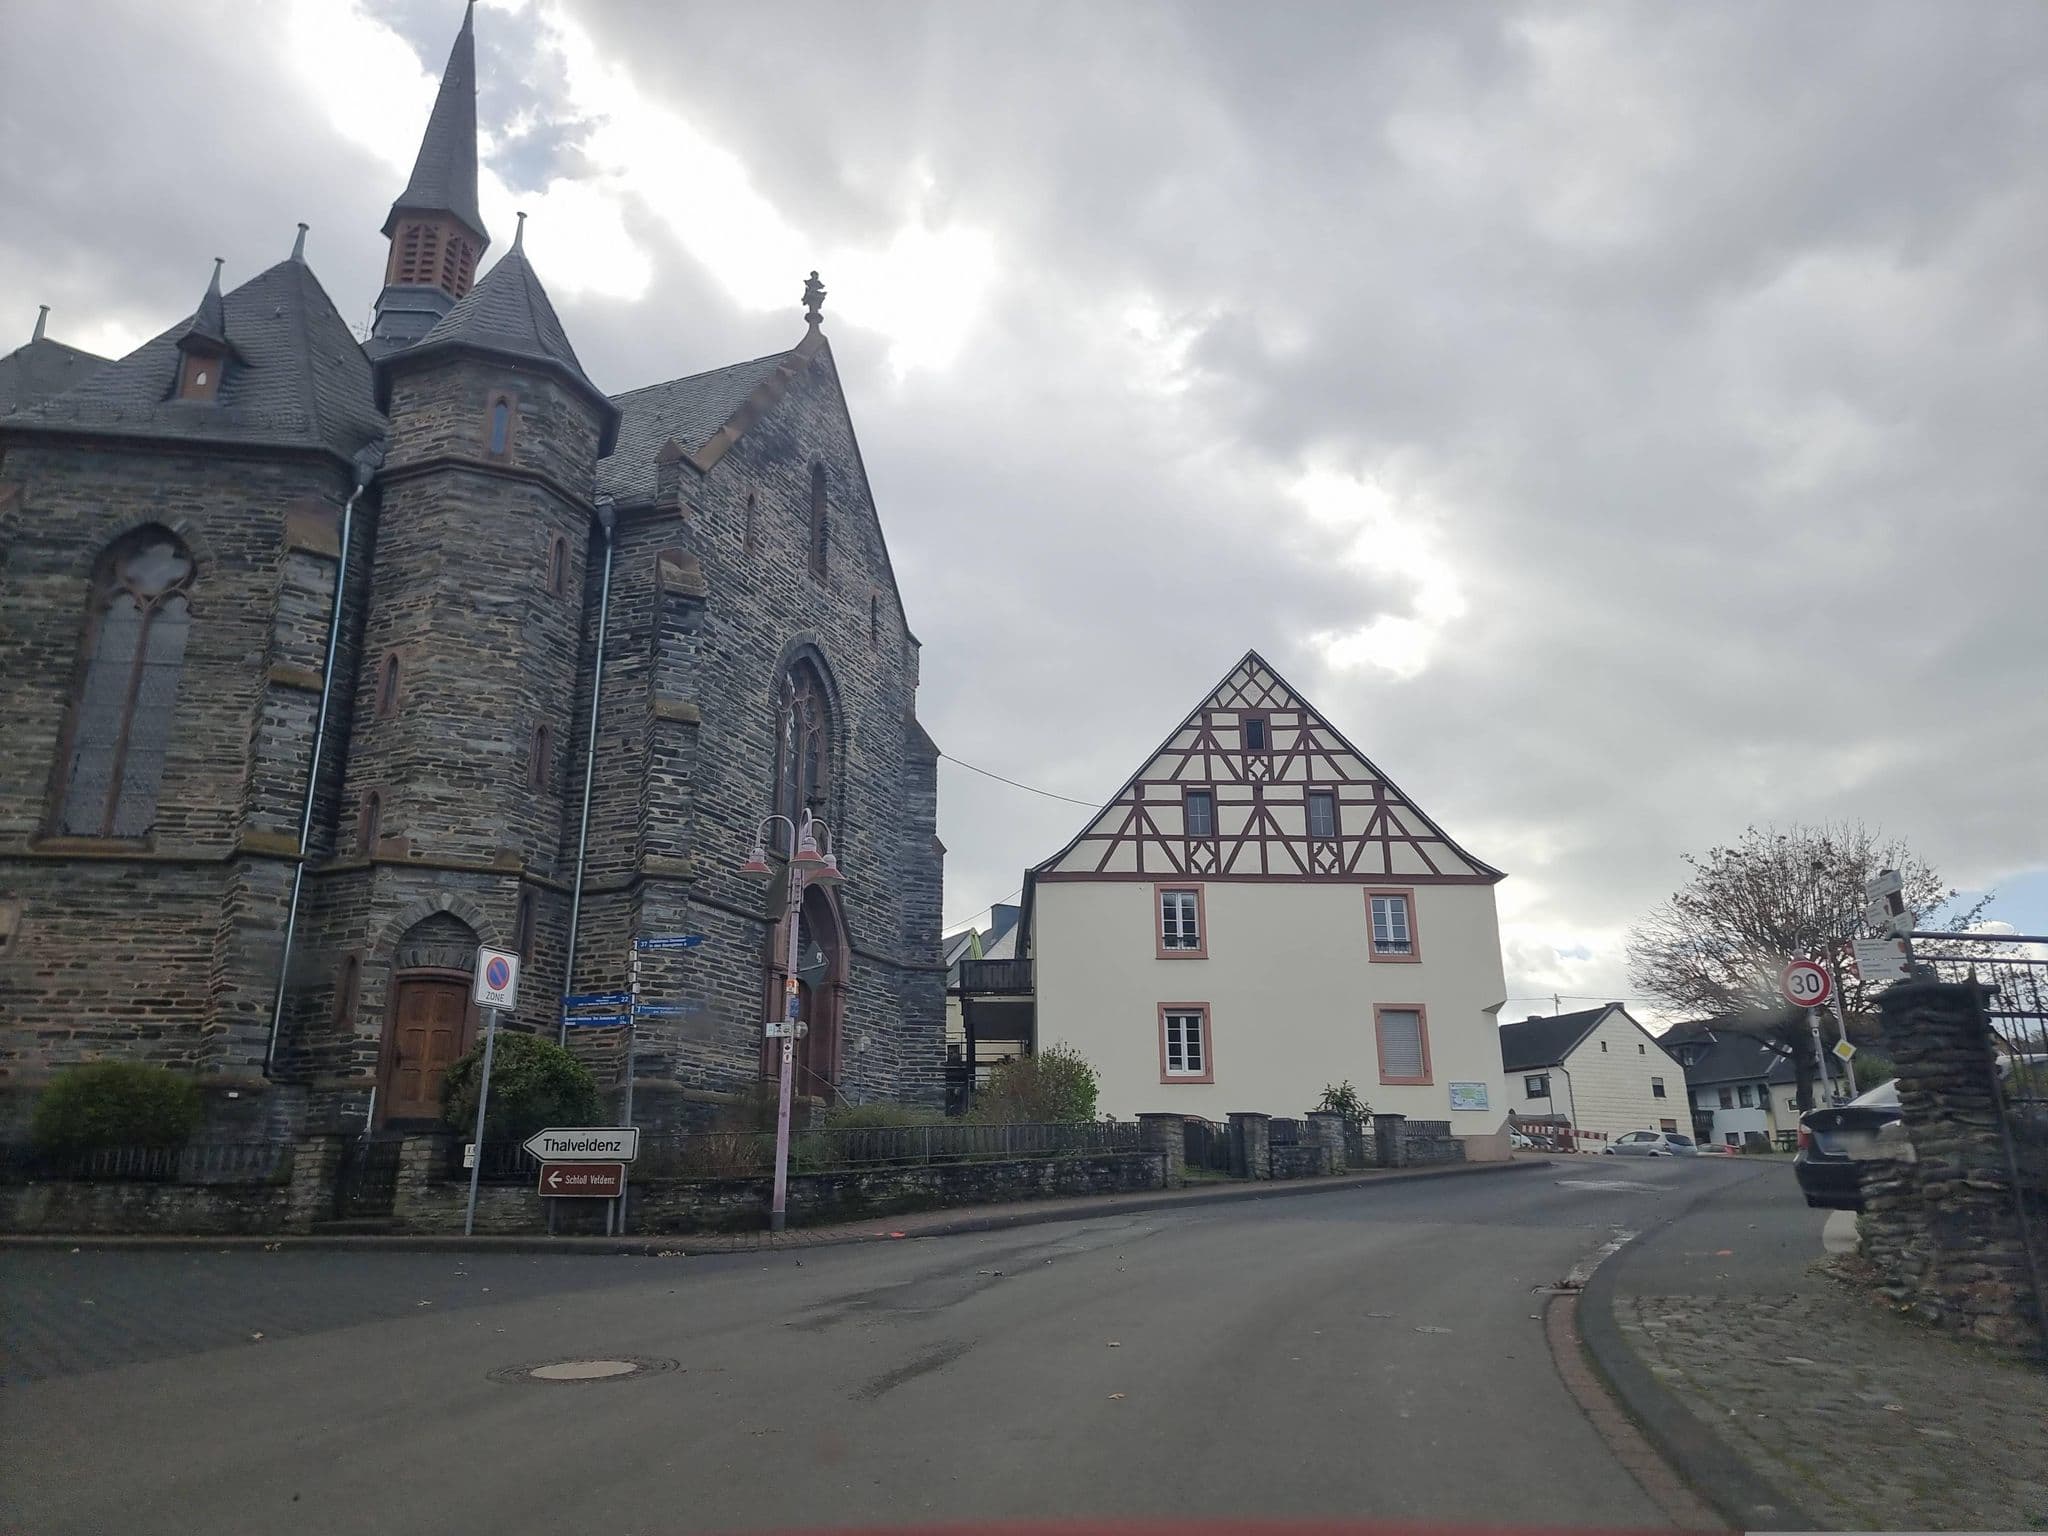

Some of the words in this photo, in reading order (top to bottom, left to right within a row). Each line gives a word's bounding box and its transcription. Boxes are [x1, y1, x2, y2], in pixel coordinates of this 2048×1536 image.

[1791, 973, 1820, 994] 30
[485, 991, 505, 1002] ZONE
[543, 1138, 621, 1152] Thalveldenz
[565, 1174, 588, 1185] Schloß
[590, 1175, 615, 1185] Veldenz
